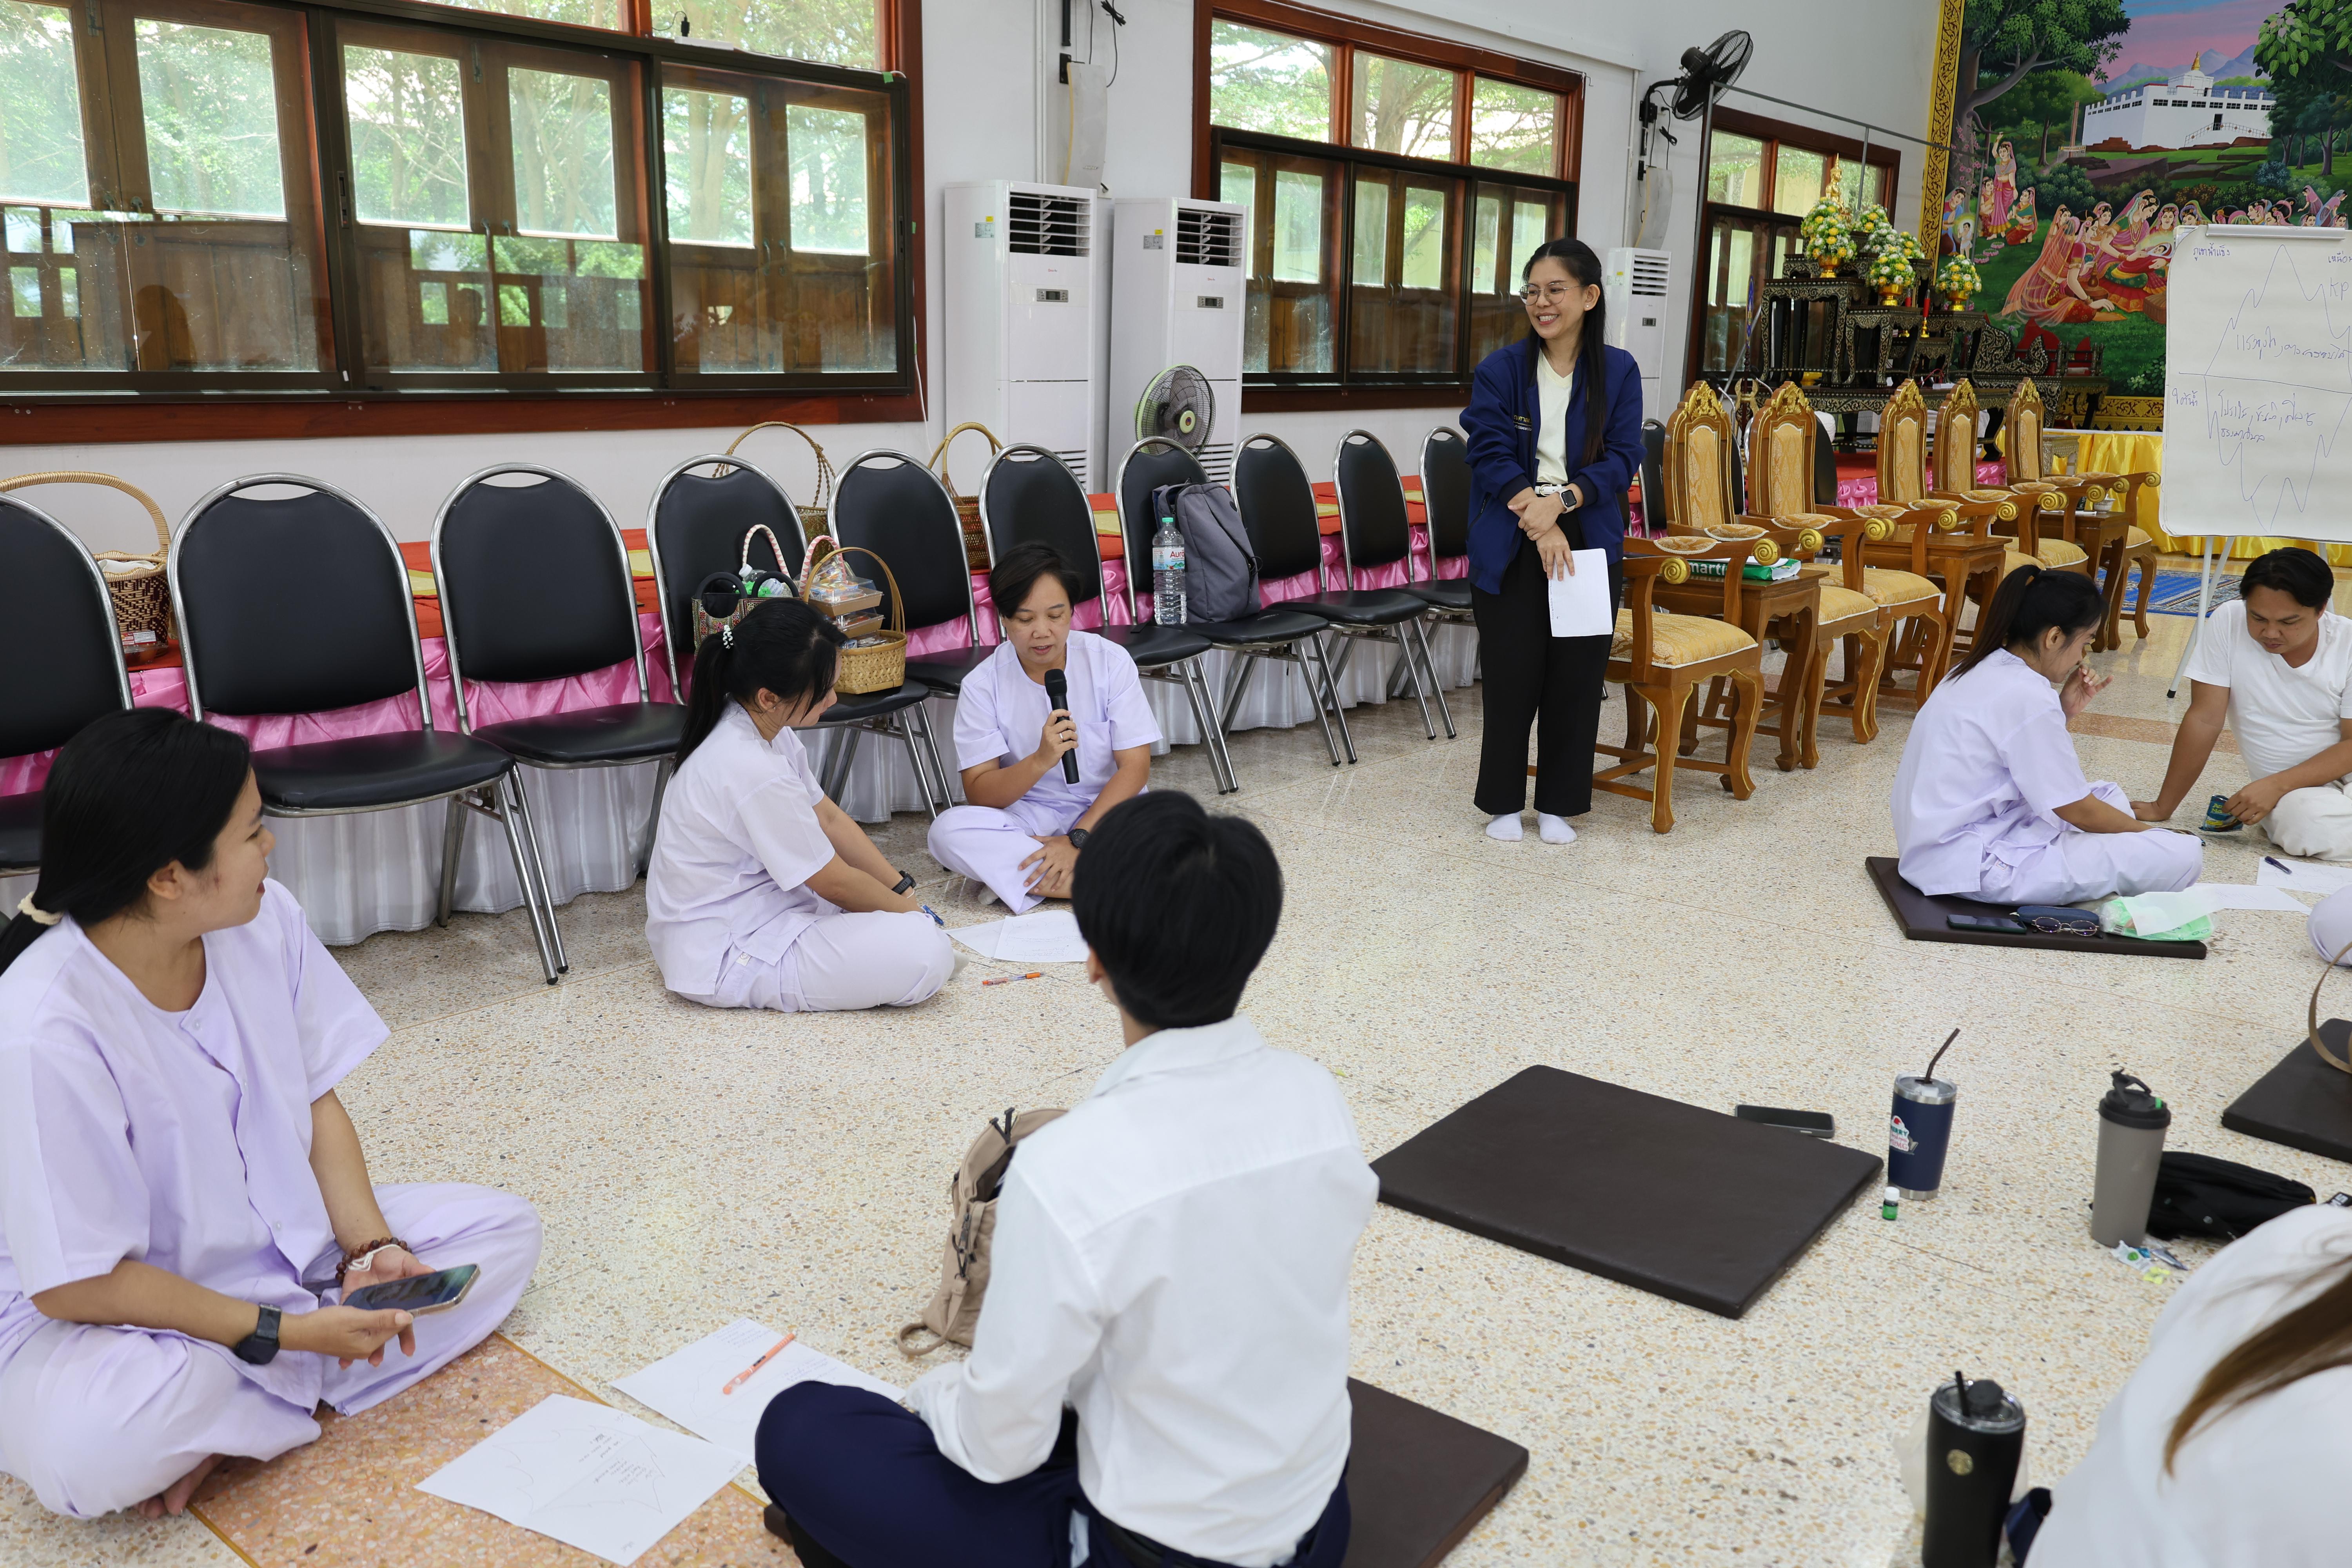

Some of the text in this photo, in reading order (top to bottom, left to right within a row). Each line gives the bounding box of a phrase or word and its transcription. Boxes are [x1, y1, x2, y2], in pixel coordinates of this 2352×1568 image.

[2193, 242, 2230, 261] ภูเขาน้ำแข็ง
[2172, 388, 2198, 407] ใต้น้ำ
